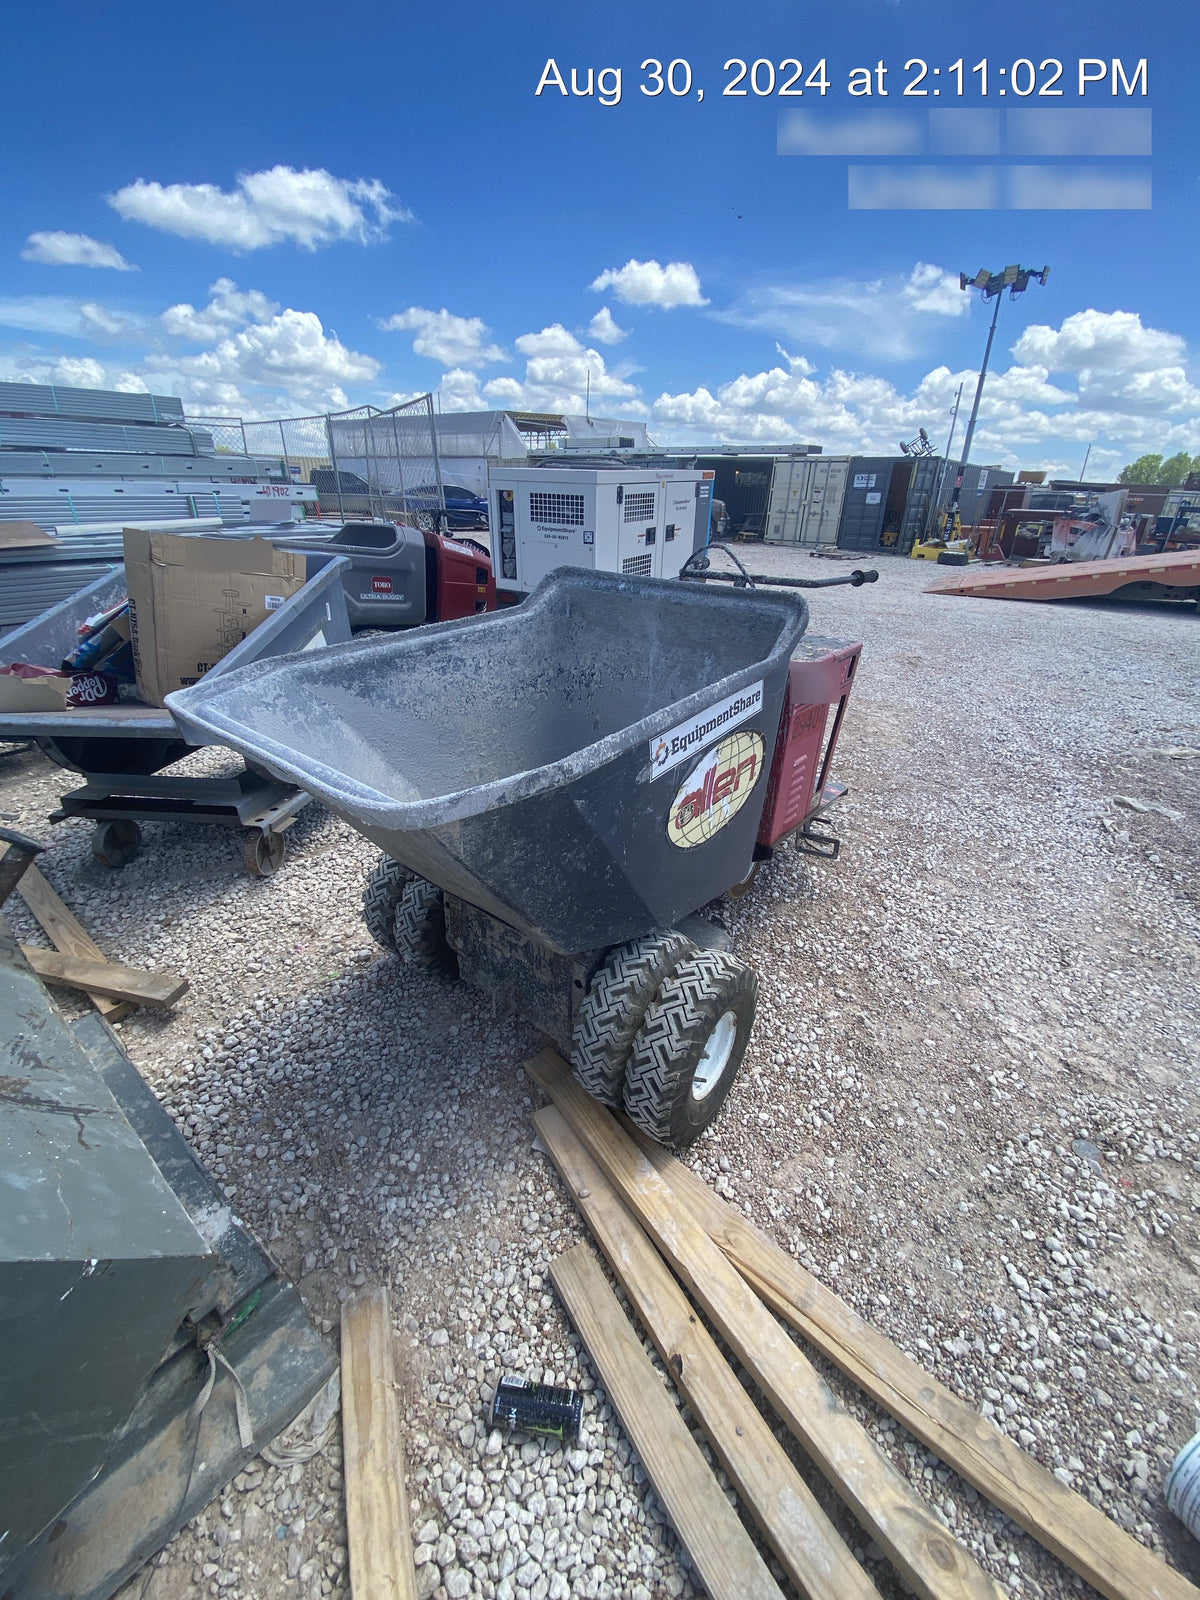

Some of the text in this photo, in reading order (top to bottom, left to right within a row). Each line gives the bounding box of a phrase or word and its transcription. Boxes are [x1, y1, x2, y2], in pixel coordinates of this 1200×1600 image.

[66, 675, 107, 698] Pepper
[80, 688, 97, 701] Dr
[670, 690, 761, 756] EquipmentShare
[675, 753, 757, 830] allen
